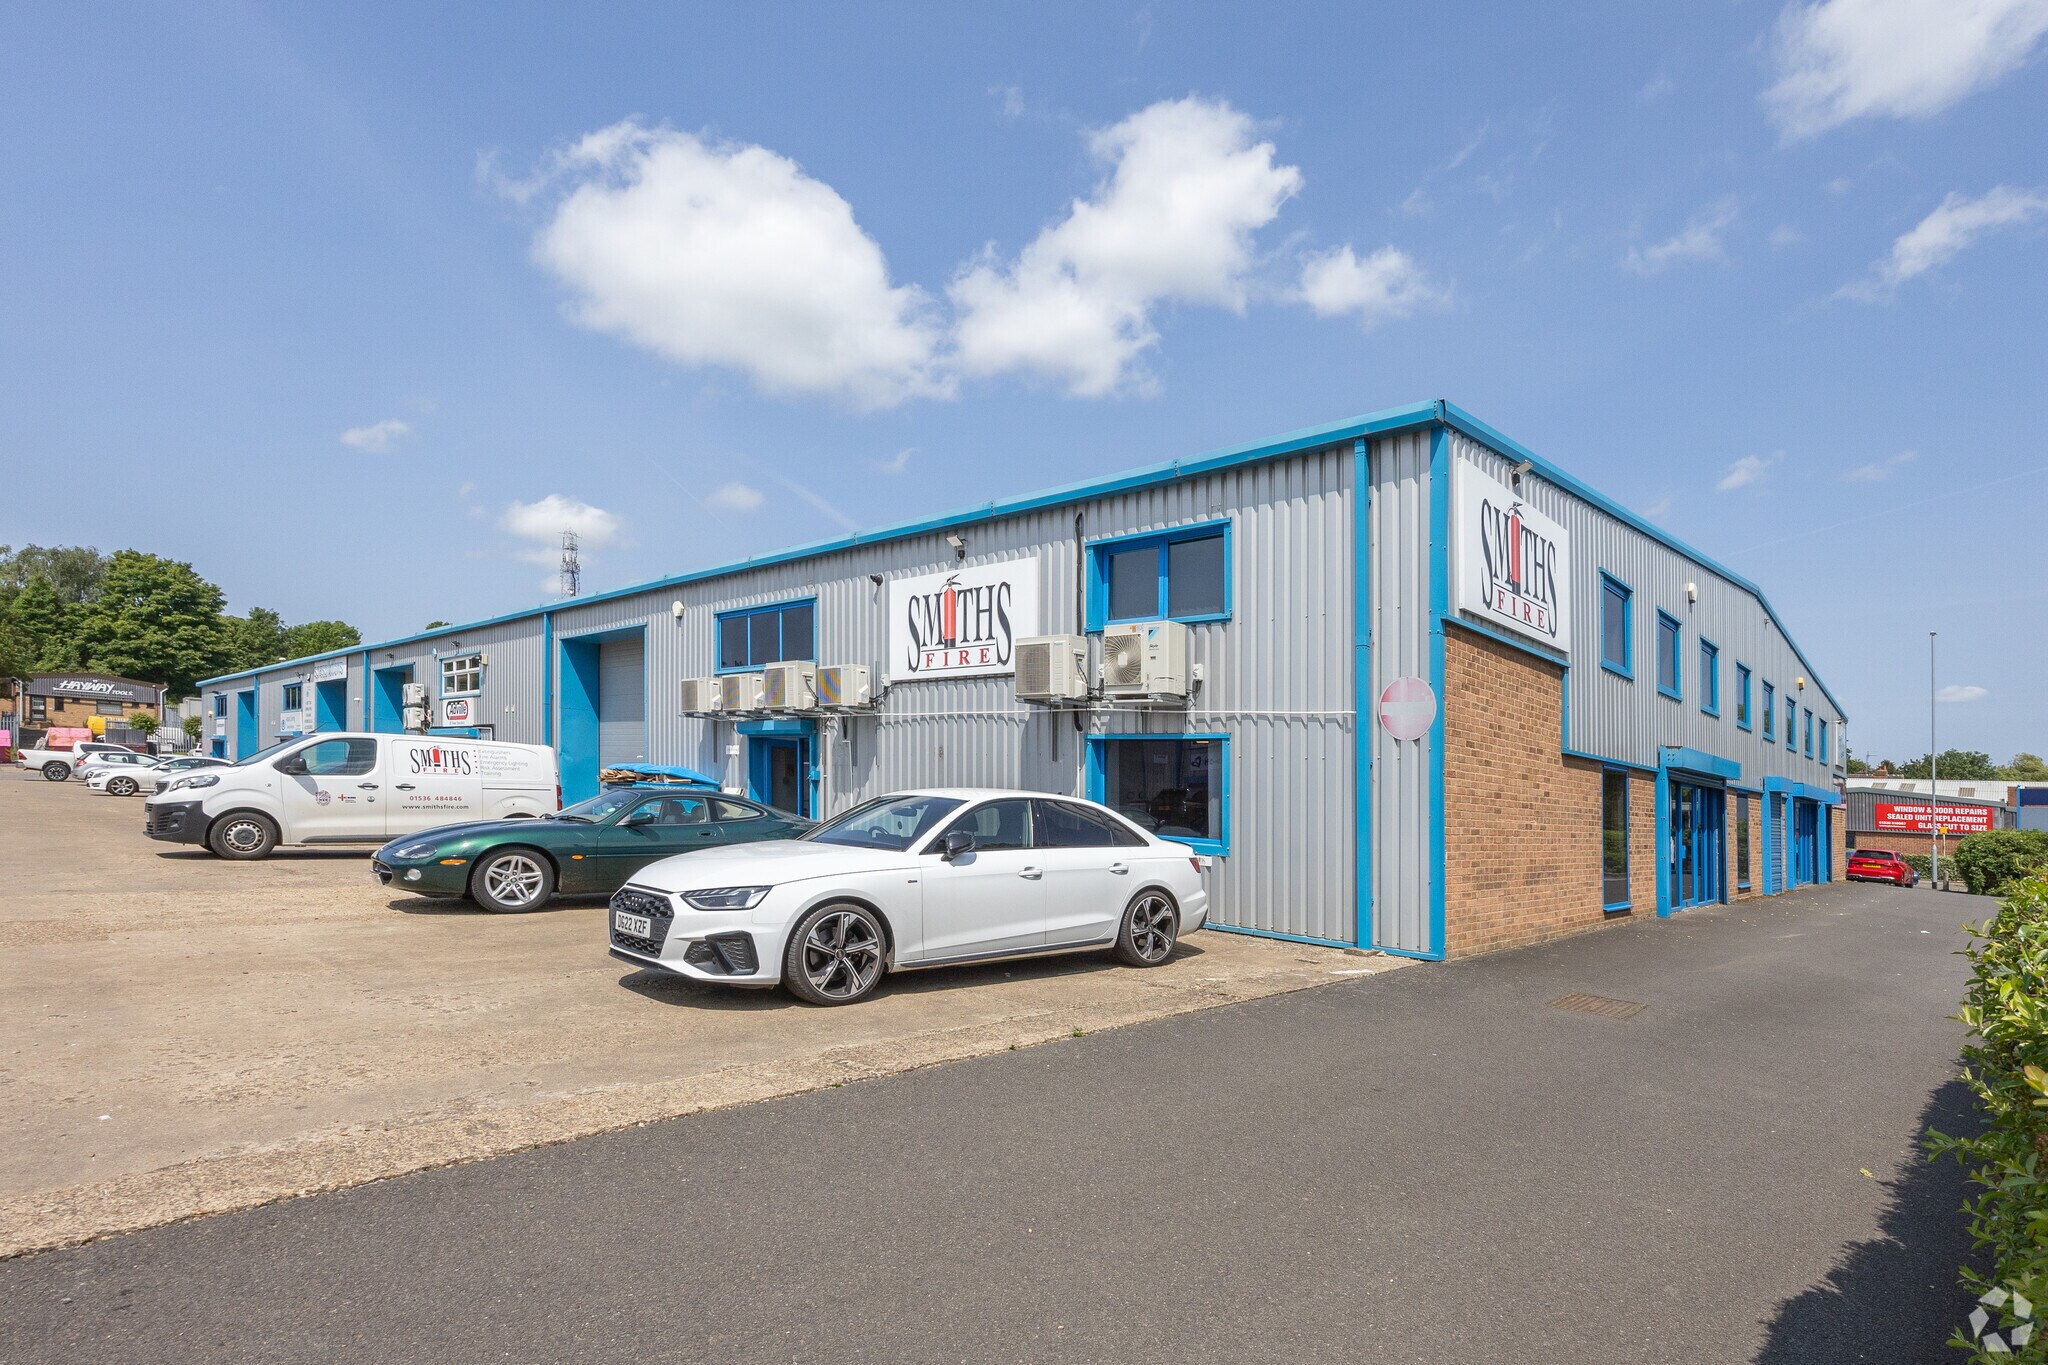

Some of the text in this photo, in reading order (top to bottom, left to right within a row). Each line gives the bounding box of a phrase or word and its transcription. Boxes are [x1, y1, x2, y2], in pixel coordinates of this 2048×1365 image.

[1481, 498, 1557, 638] SMITHS
[1497, 588, 1545, 629] FIRE
[907, 580, 1012, 673] SMITHS
[925, 647, 990, 668] FIRE
[59, 680, 115, 694] HAYWAY
[410, 747, 471, 775] SMITHS
[1935, 815, 1987, 823] REPLACEMENT
